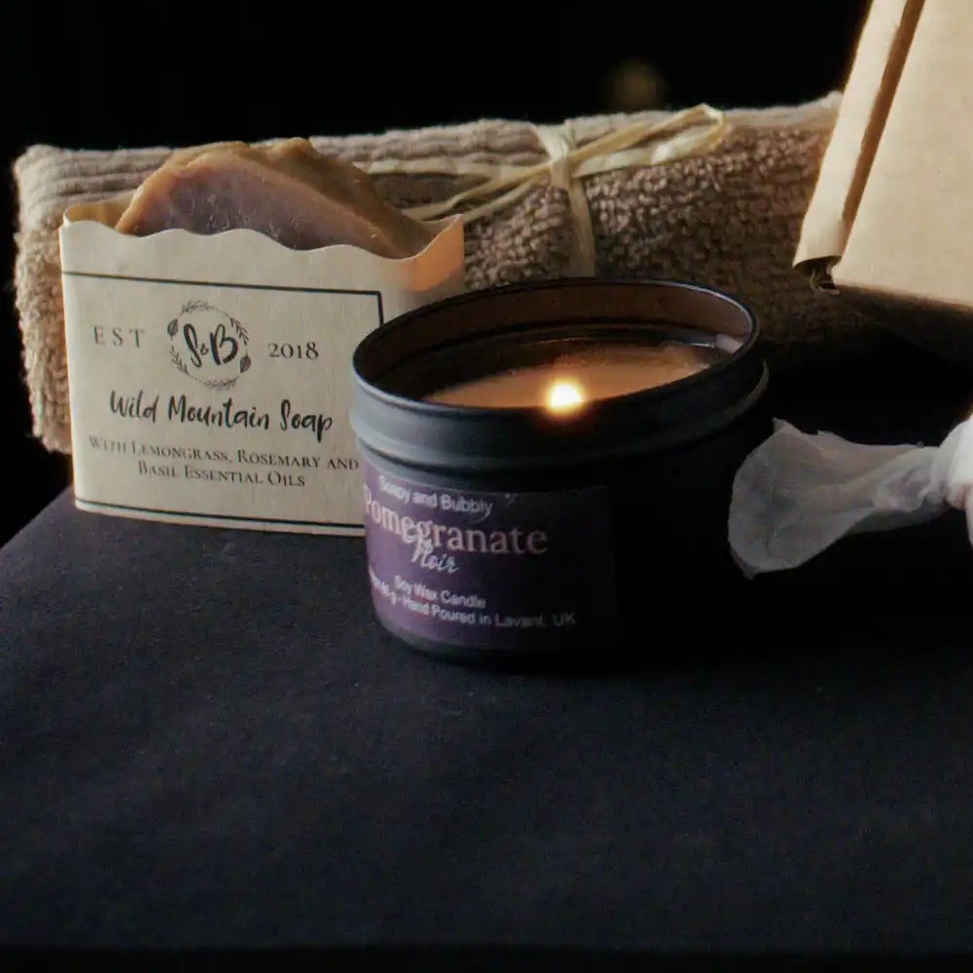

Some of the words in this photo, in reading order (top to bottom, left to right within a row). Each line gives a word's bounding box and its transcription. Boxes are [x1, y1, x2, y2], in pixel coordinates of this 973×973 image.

[92, 325, 145, 348] EST
[268, 341, 320, 360] 2018
[109, 390, 159, 423] Wild
[168, 394, 270, 430] Mountain
[280, 399, 333, 443] Soap
[237, 448, 321, 469] ROSEMARY
[440, 493, 493, 517] Bubbly
[363, 483, 549, 555] Pomegranate
[440, 590, 487, 609] Candle
